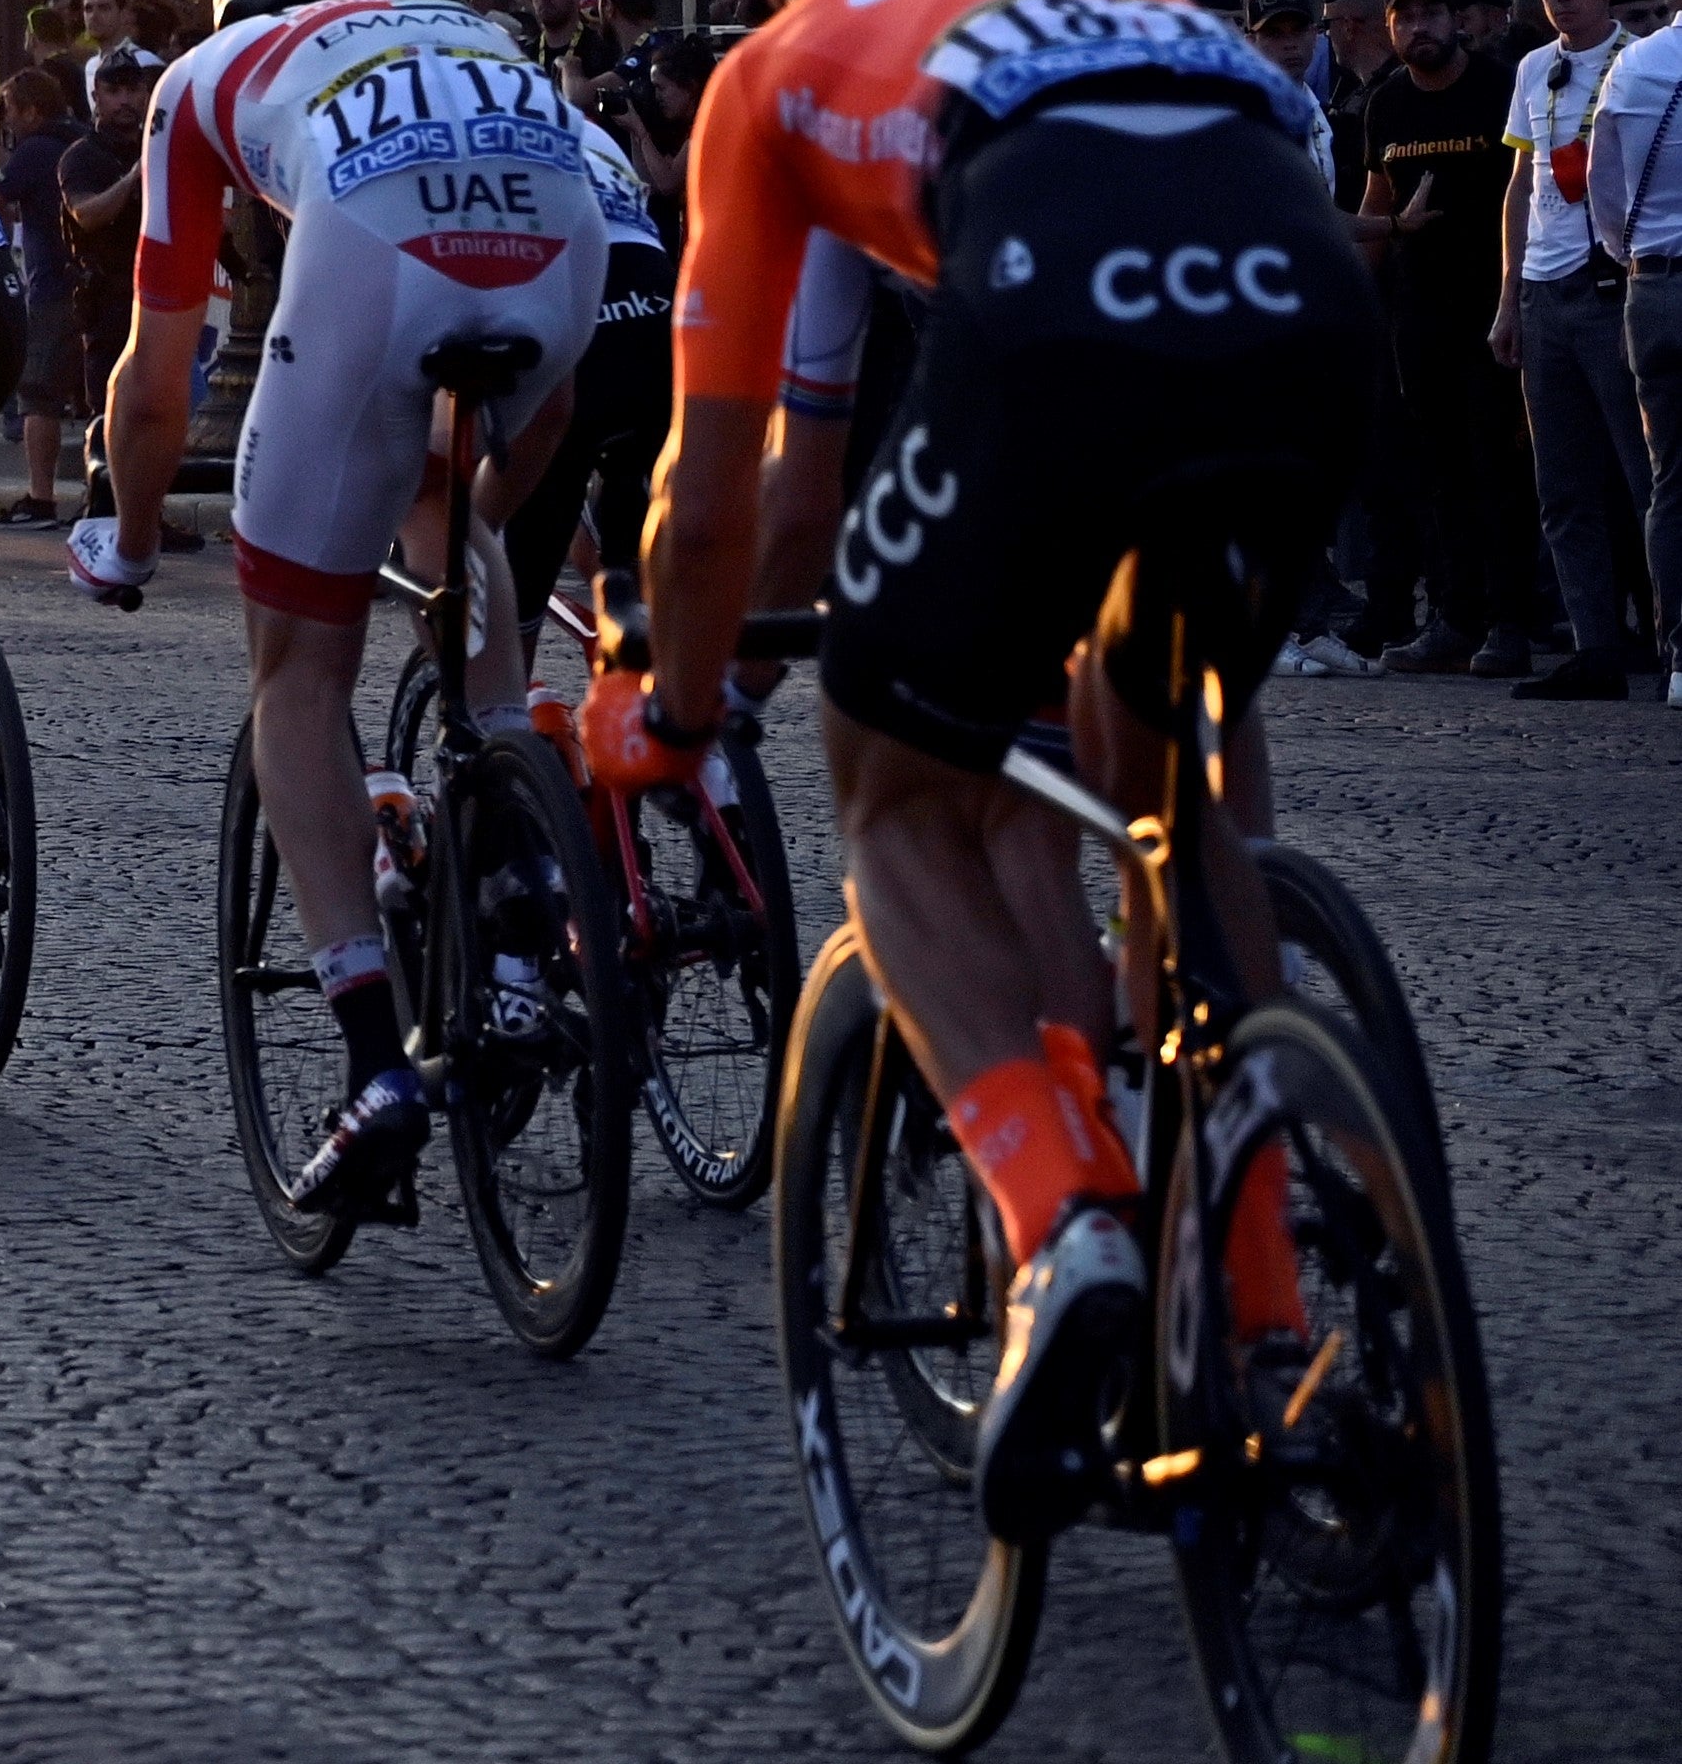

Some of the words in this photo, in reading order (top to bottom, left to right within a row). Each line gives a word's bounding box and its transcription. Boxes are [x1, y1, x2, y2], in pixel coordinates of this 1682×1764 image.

[323, 59, 432, 156] 127
[456, 60, 570, 131] 127
[1382, 135, 1472, 163] Continental
[418, 172, 538, 215] UAE
[1091, 244, 1302, 322] CCC
[835, 424, 959, 606] CCC
